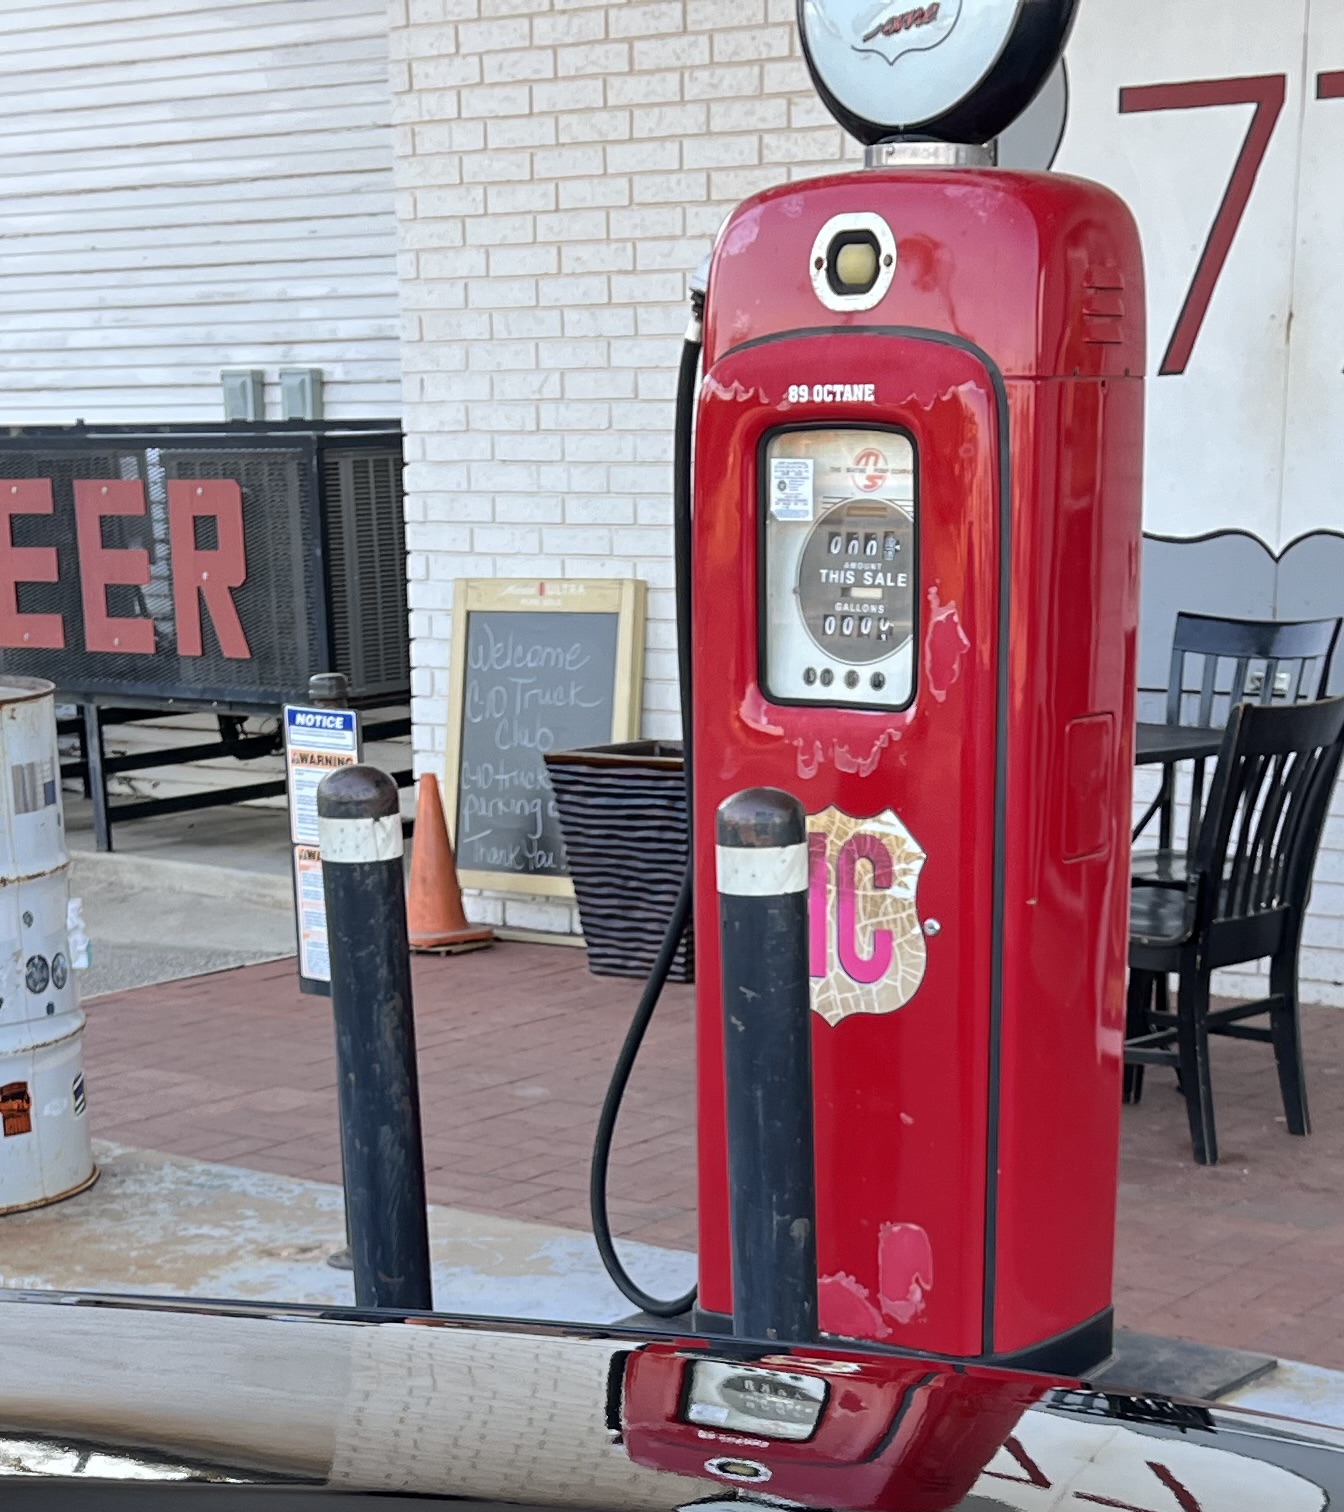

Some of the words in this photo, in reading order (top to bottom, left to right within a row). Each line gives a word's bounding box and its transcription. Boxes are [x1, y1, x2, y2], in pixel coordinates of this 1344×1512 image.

[788, 385, 809, 403] 89
[813, 384, 875, 402] OCTANE
[843, 561, 883, 571] AMOUNT
[819, 569, 856, 584] THIS
[863, 571, 908, 587] SALE
[834, 602, 885, 614] GALLONS
[467, 622, 591, 671] Welcome
[508, 676, 605, 714] Truck
[295, 713, 344, 729] NOTICE
[495, 714, 554, 752] Club
